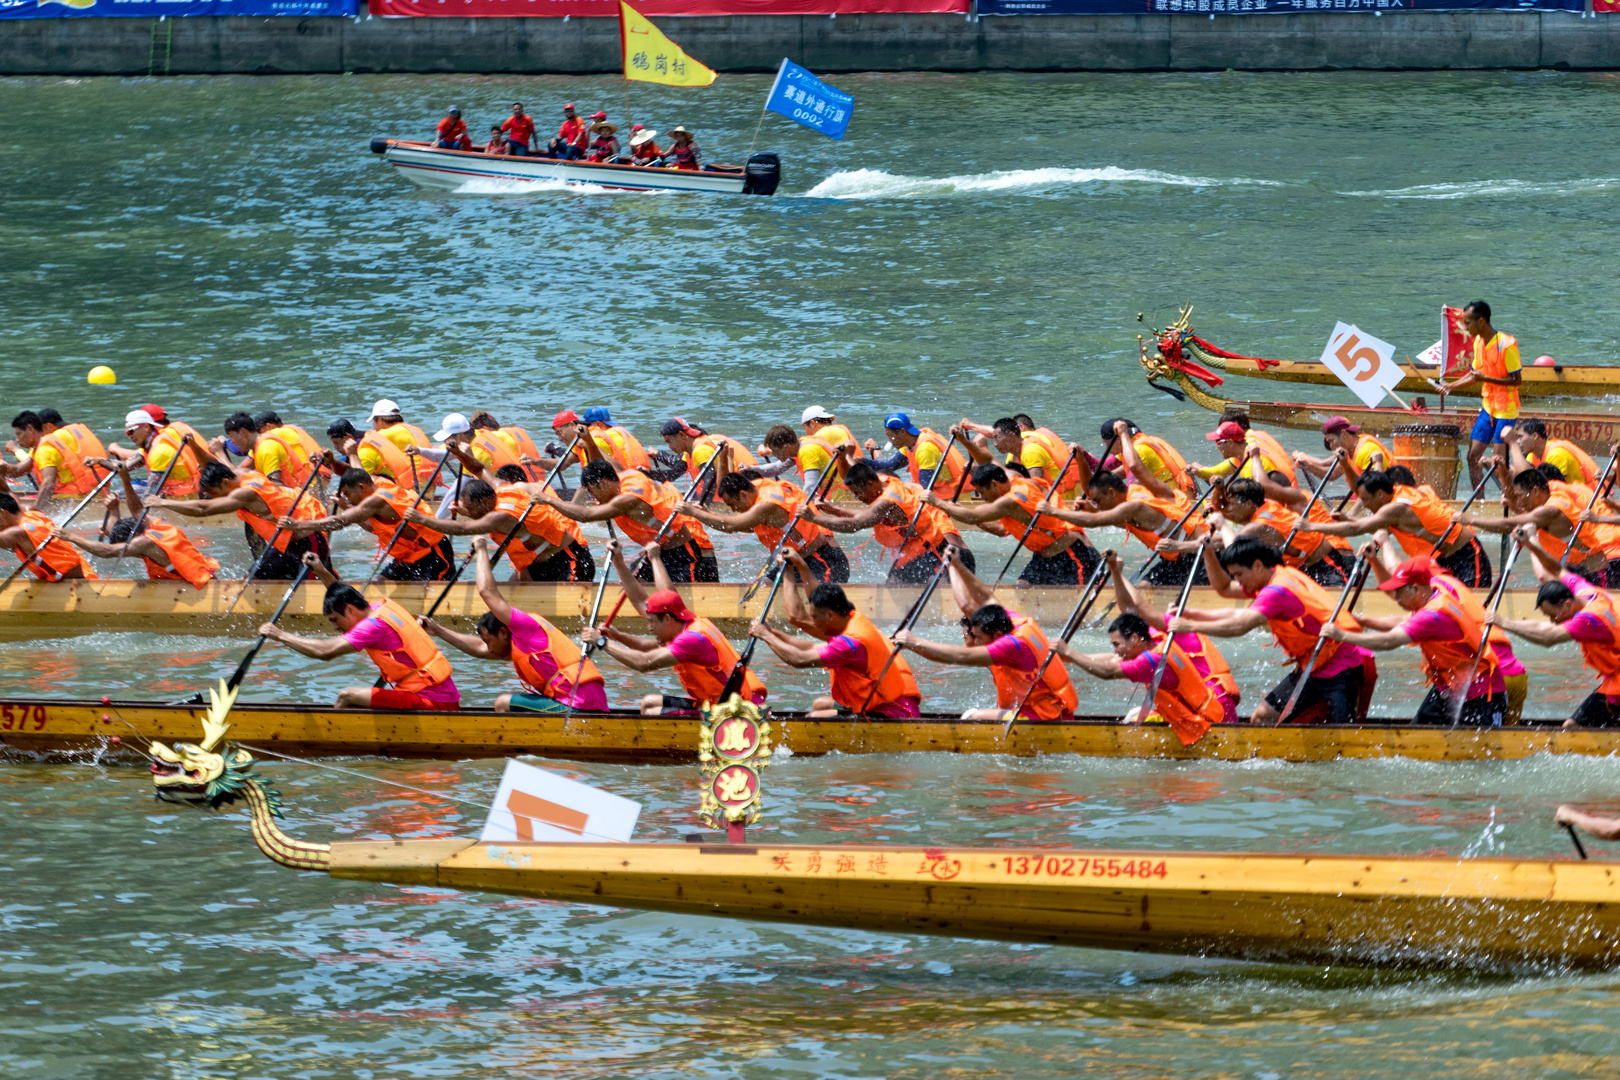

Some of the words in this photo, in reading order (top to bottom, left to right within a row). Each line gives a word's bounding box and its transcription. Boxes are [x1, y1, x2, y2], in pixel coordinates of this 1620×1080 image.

[784, 84, 845, 123] 赛道外通行旗
[793, 108, 824, 127] 0002
[1334, 333, 1381, 382] 5
[2, 704, 47, 731] 579
[773, 852, 888, 876] 关勇强造
[1003, 856, 1168, 880] 13702755484
